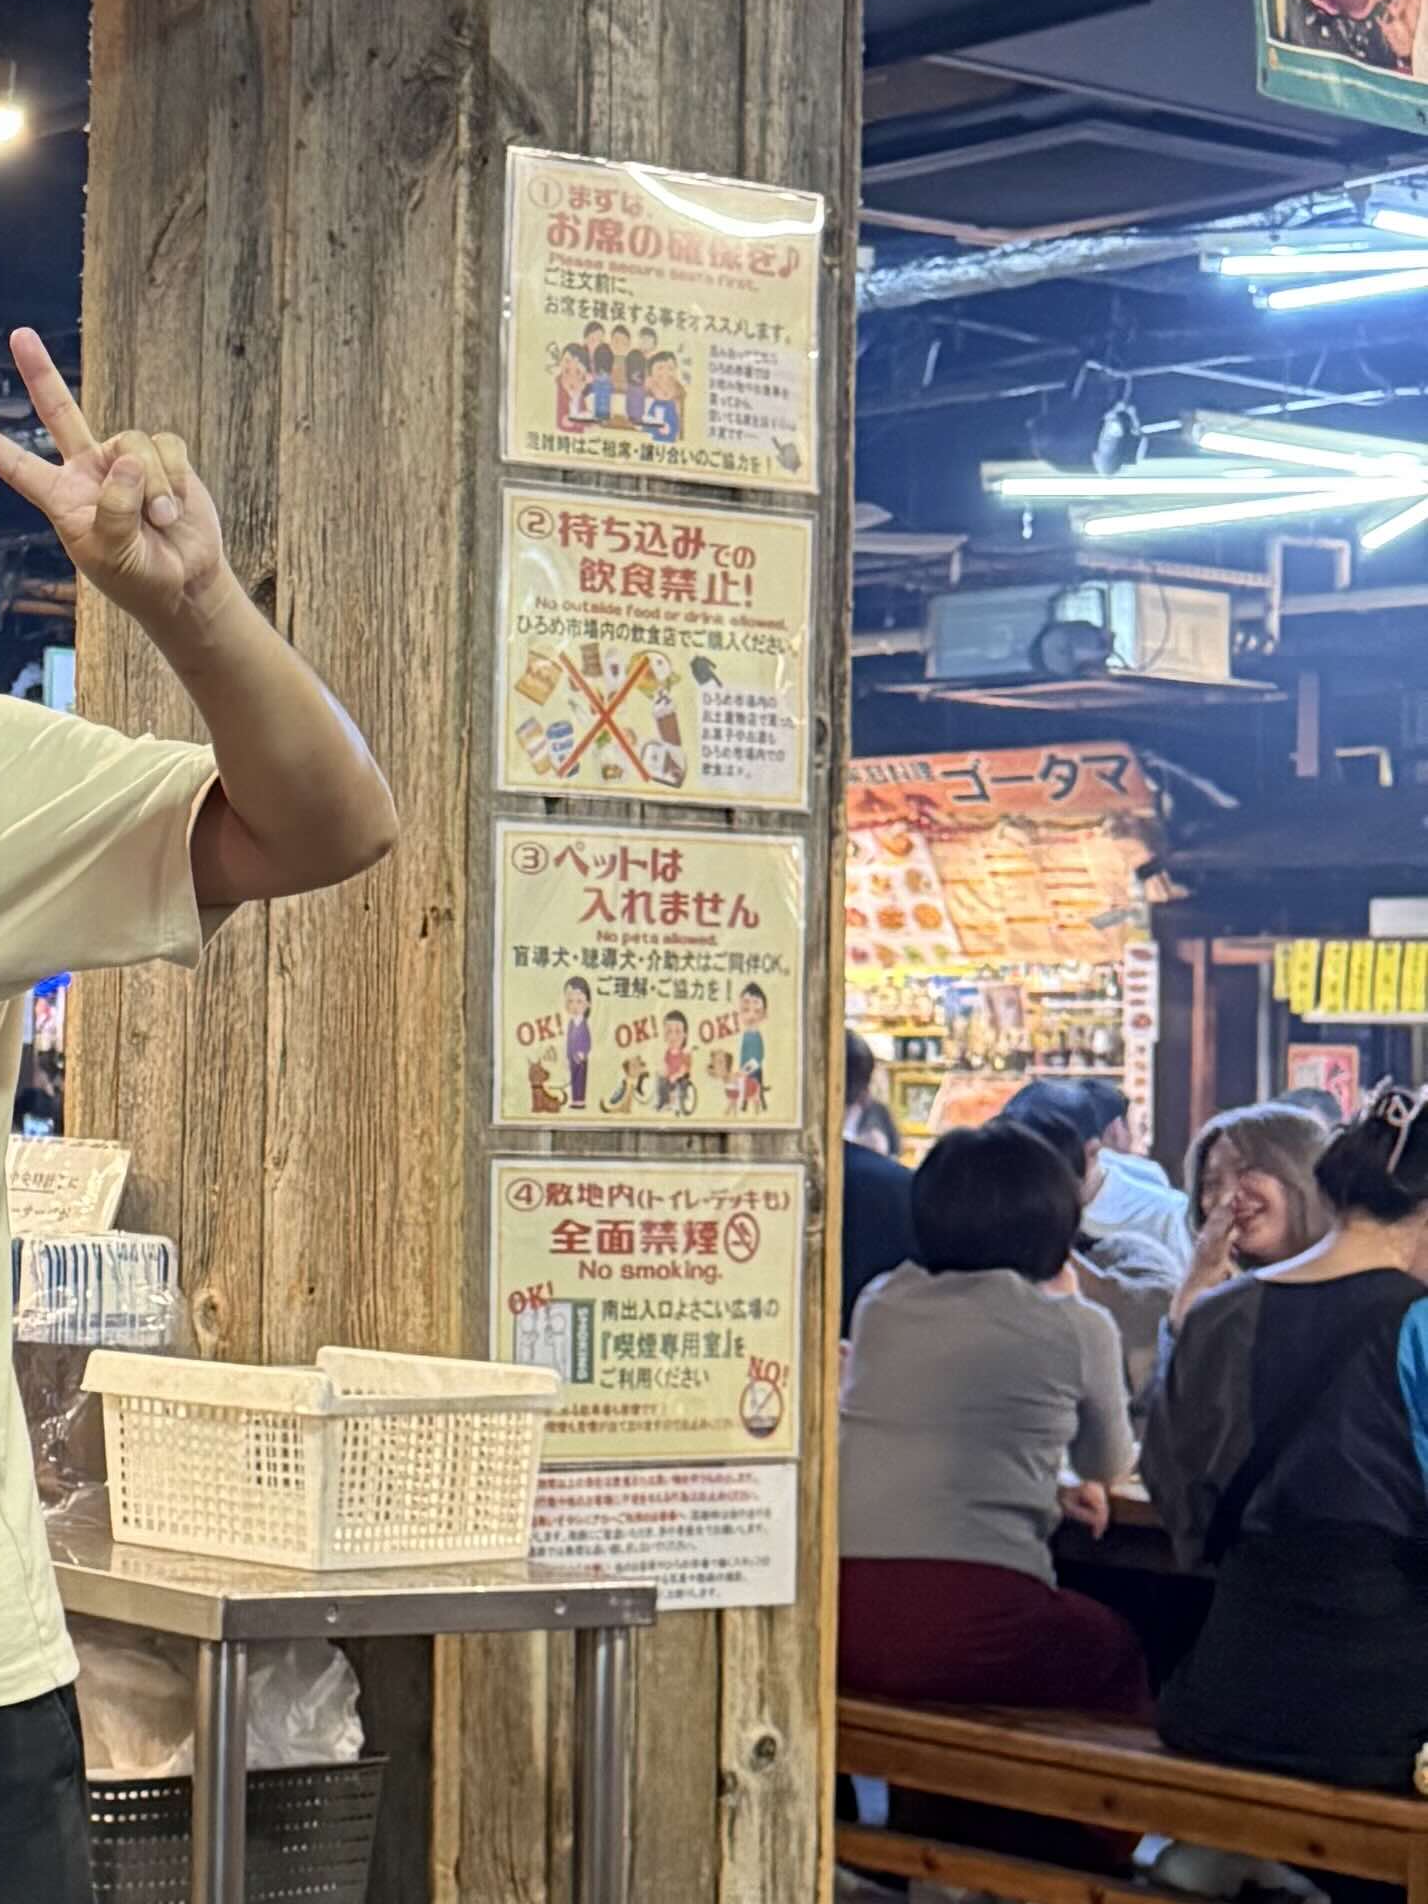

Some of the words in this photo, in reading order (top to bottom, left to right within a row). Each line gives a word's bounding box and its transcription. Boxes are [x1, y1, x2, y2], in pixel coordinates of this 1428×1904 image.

[545, 267, 635, 297] ご注文前に、
[549, 252, 604, 271] Please
[609, 258, 664, 278] secure
[670, 268, 714, 286] seats
[535, 596, 557, 611] No
[563, 600, 622, 617] outside
[626, 604, 661, 621] food
[665, 609, 680, 622] or
[685, 608, 724, 627] drink
[940, 753, 1131, 803] ゴータマ
[578, 887, 760, 930] 入れません
[597, 930, 617, 943] No
[621, 931, 659, 947] pets
[516, 1013, 563, 1047] OK!
[614, 1014, 659, 1048] OK!
[698, 1011, 740, 1044] OK!
[549, 1218, 719, 1256] 全面禁煙
[579, 1260, 612, 1280] No
[620, 1259, 724, 1285] smoking.
[508, 1281, 554, 1315] OK!
[601, 1298, 778, 1323] 南出入口よさこい広場の
[600, 1365, 711, 1391] ご利用ください
[747, 1356, 790, 1387] NO!
